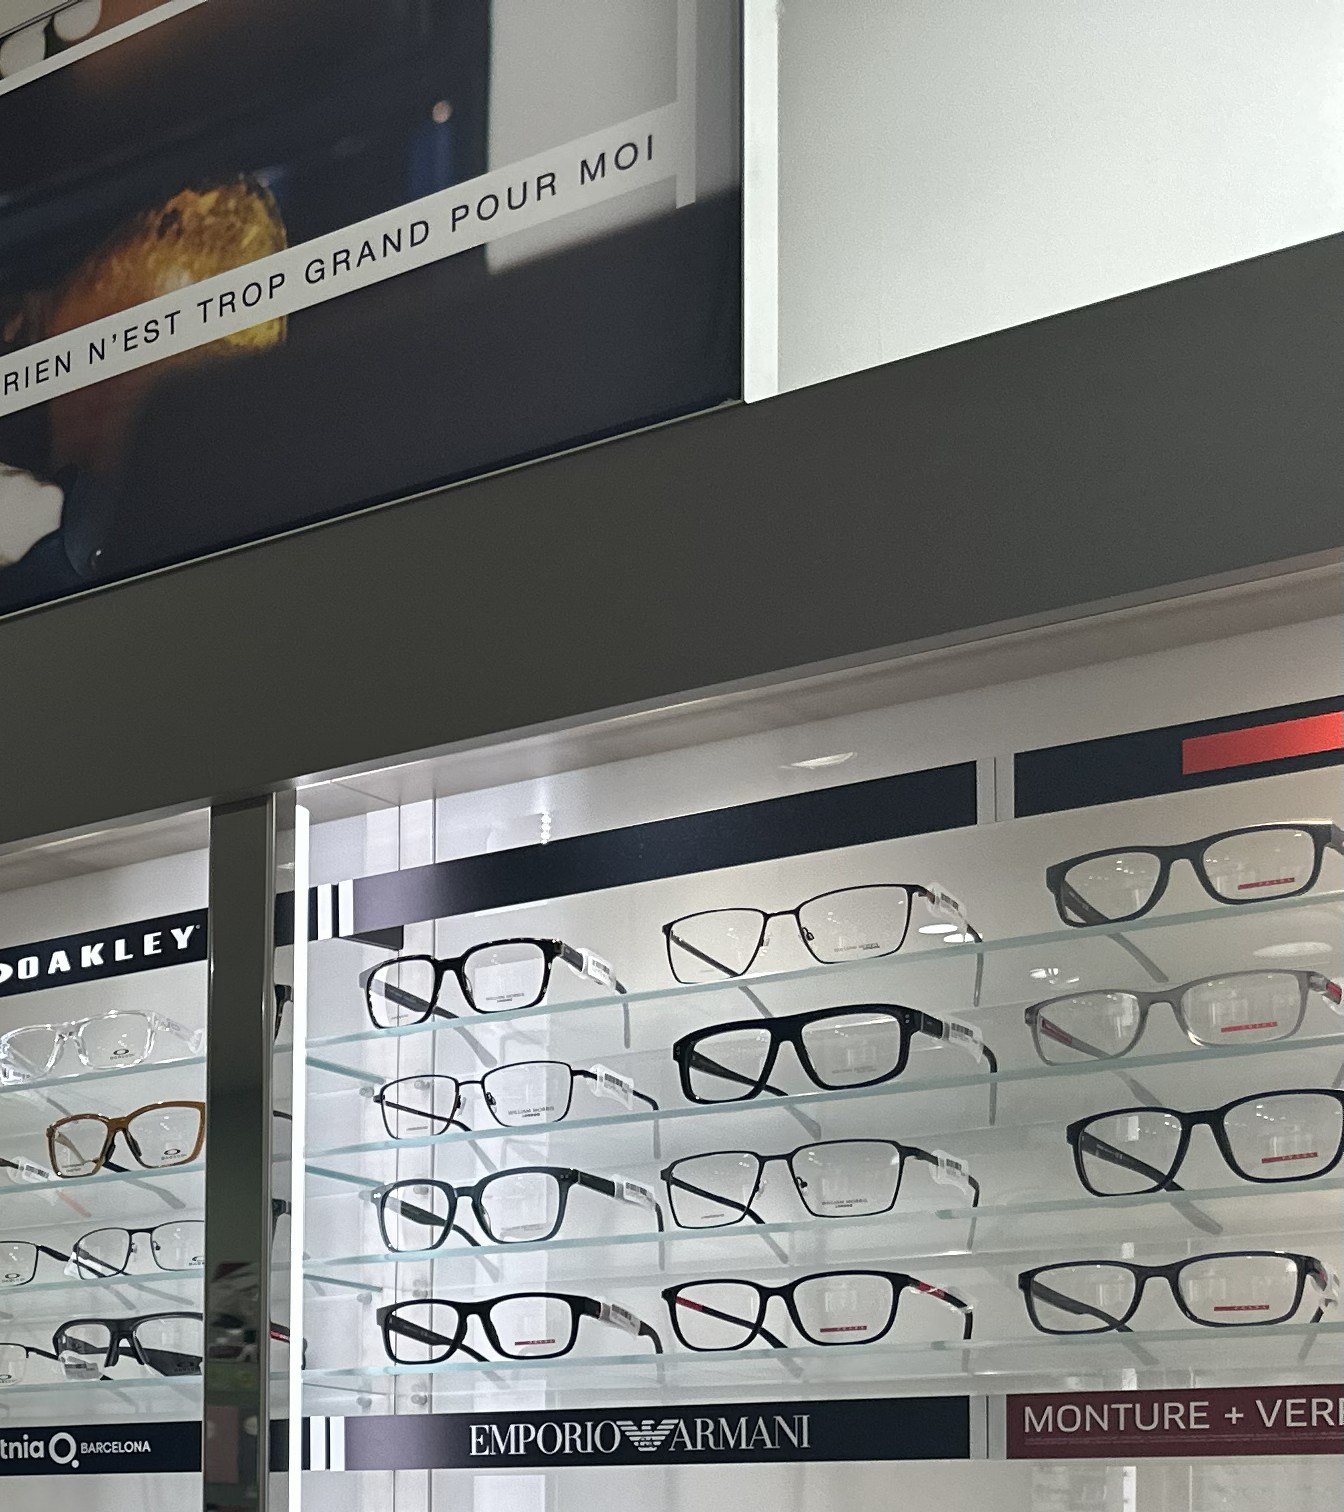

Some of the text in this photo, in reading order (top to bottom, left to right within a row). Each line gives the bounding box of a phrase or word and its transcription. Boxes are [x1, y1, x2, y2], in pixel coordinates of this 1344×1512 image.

[2, 133, 654, 397] RIEN N'EST TROP GRAND POUR MOI
[17, 924, 197, 980] OAKLEY
[468, 1414, 812, 1457] EMPORIO ARMANI
[1023, 1397, 1344, 1433] MONTURE + VER
[80, 1440, 152, 1454] BARCELONA
